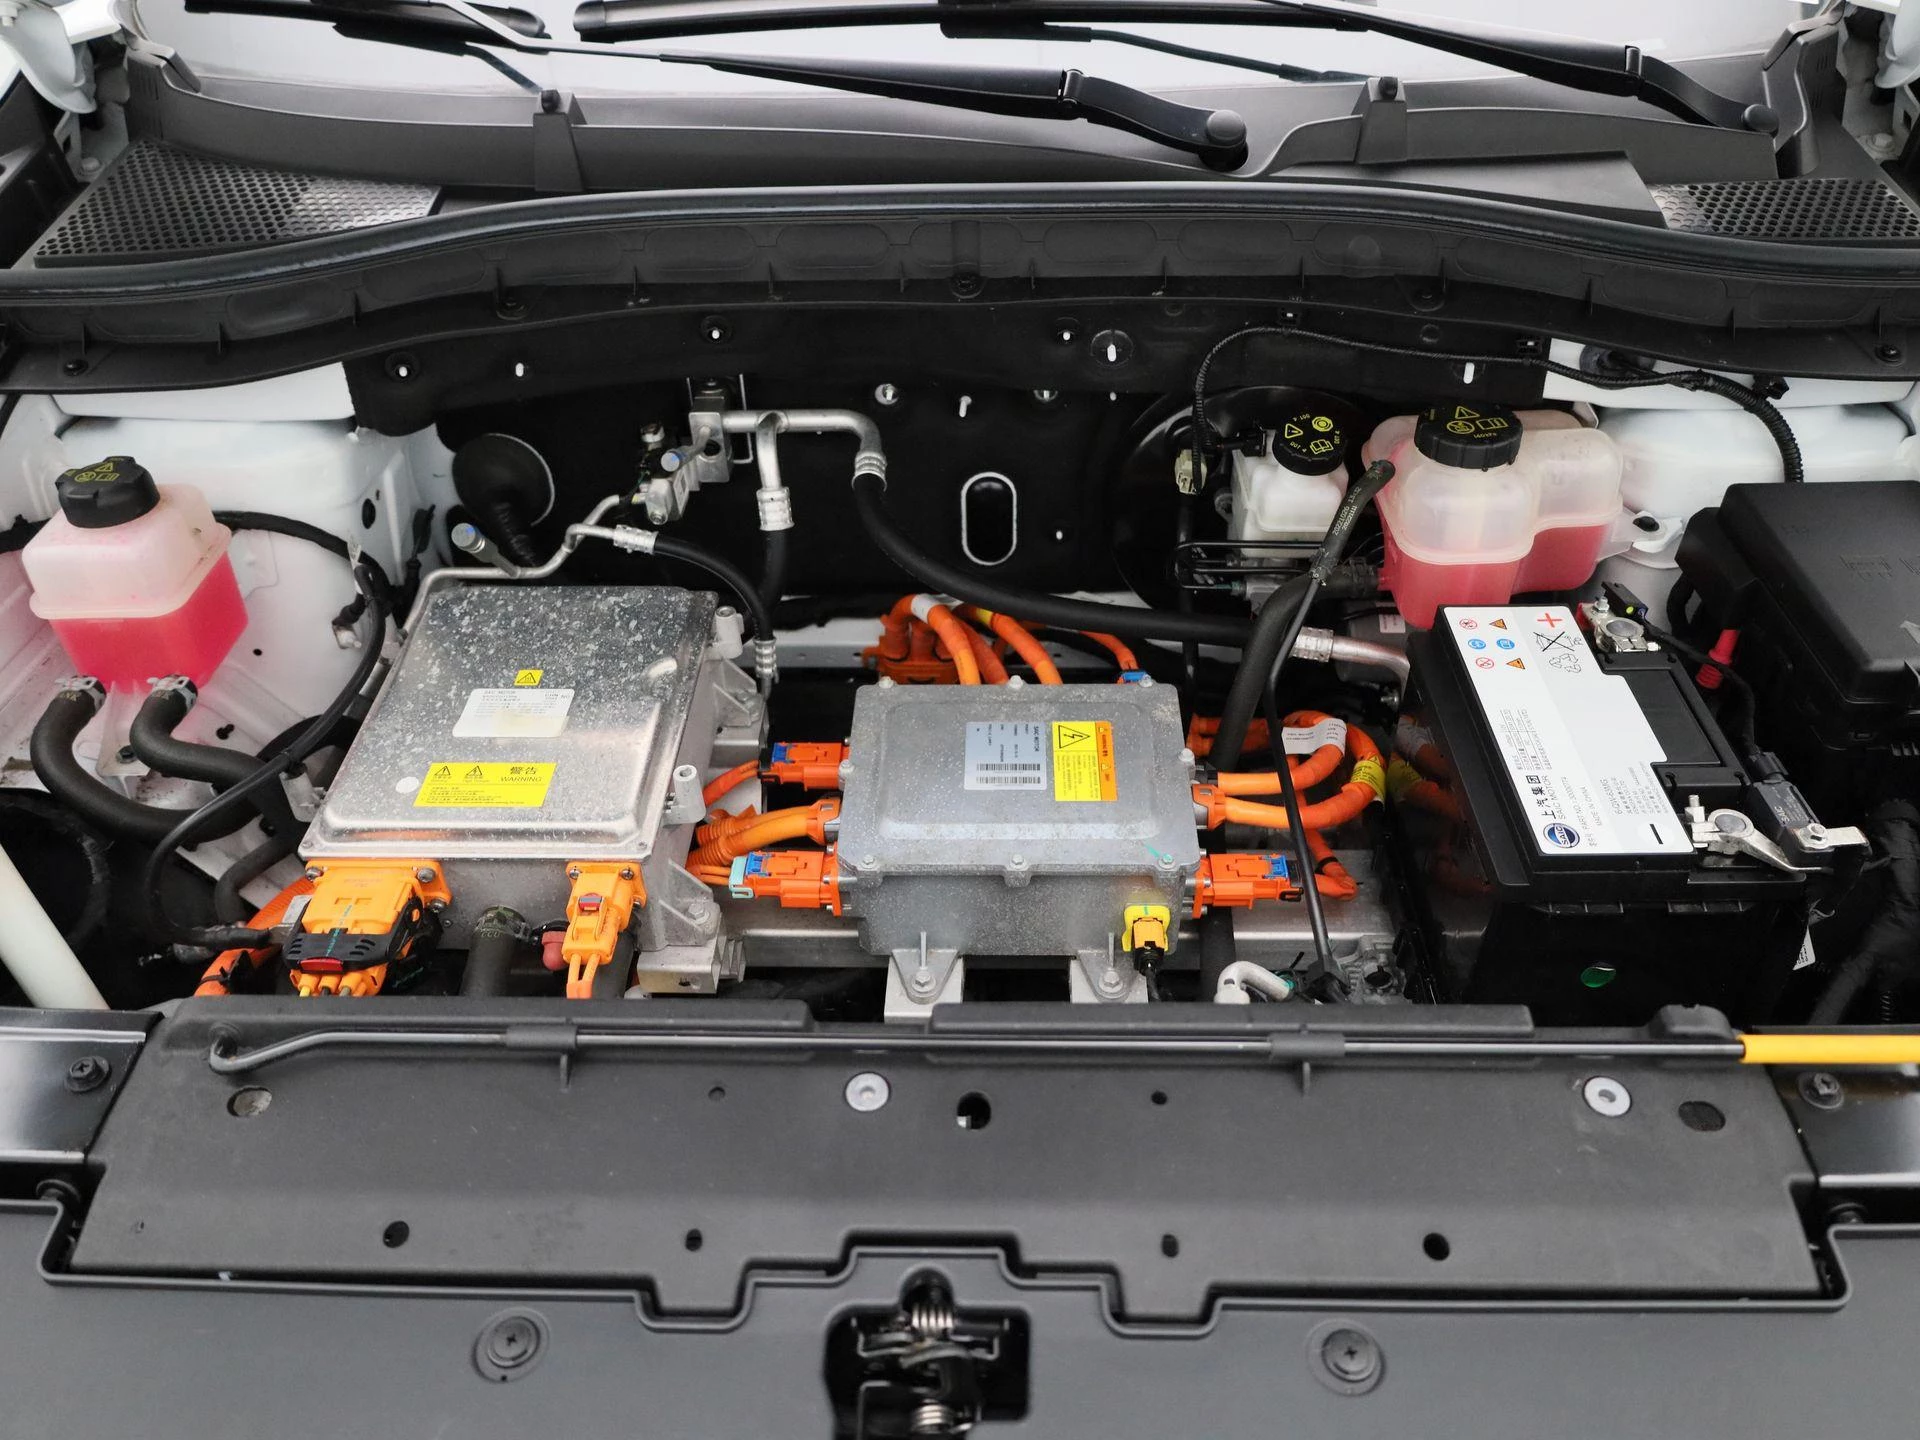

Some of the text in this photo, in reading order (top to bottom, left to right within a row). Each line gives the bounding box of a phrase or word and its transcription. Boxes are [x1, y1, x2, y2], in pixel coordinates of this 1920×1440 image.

[1332, 506, 1350, 536] 20221026
[510, 766, 537, 775] 警告
[1526, 775, 1557, 819] 上汽集团
[1541, 775, 1566, 820] SAIC MOTOR
[1556, 826, 1569, 845] SAIC
